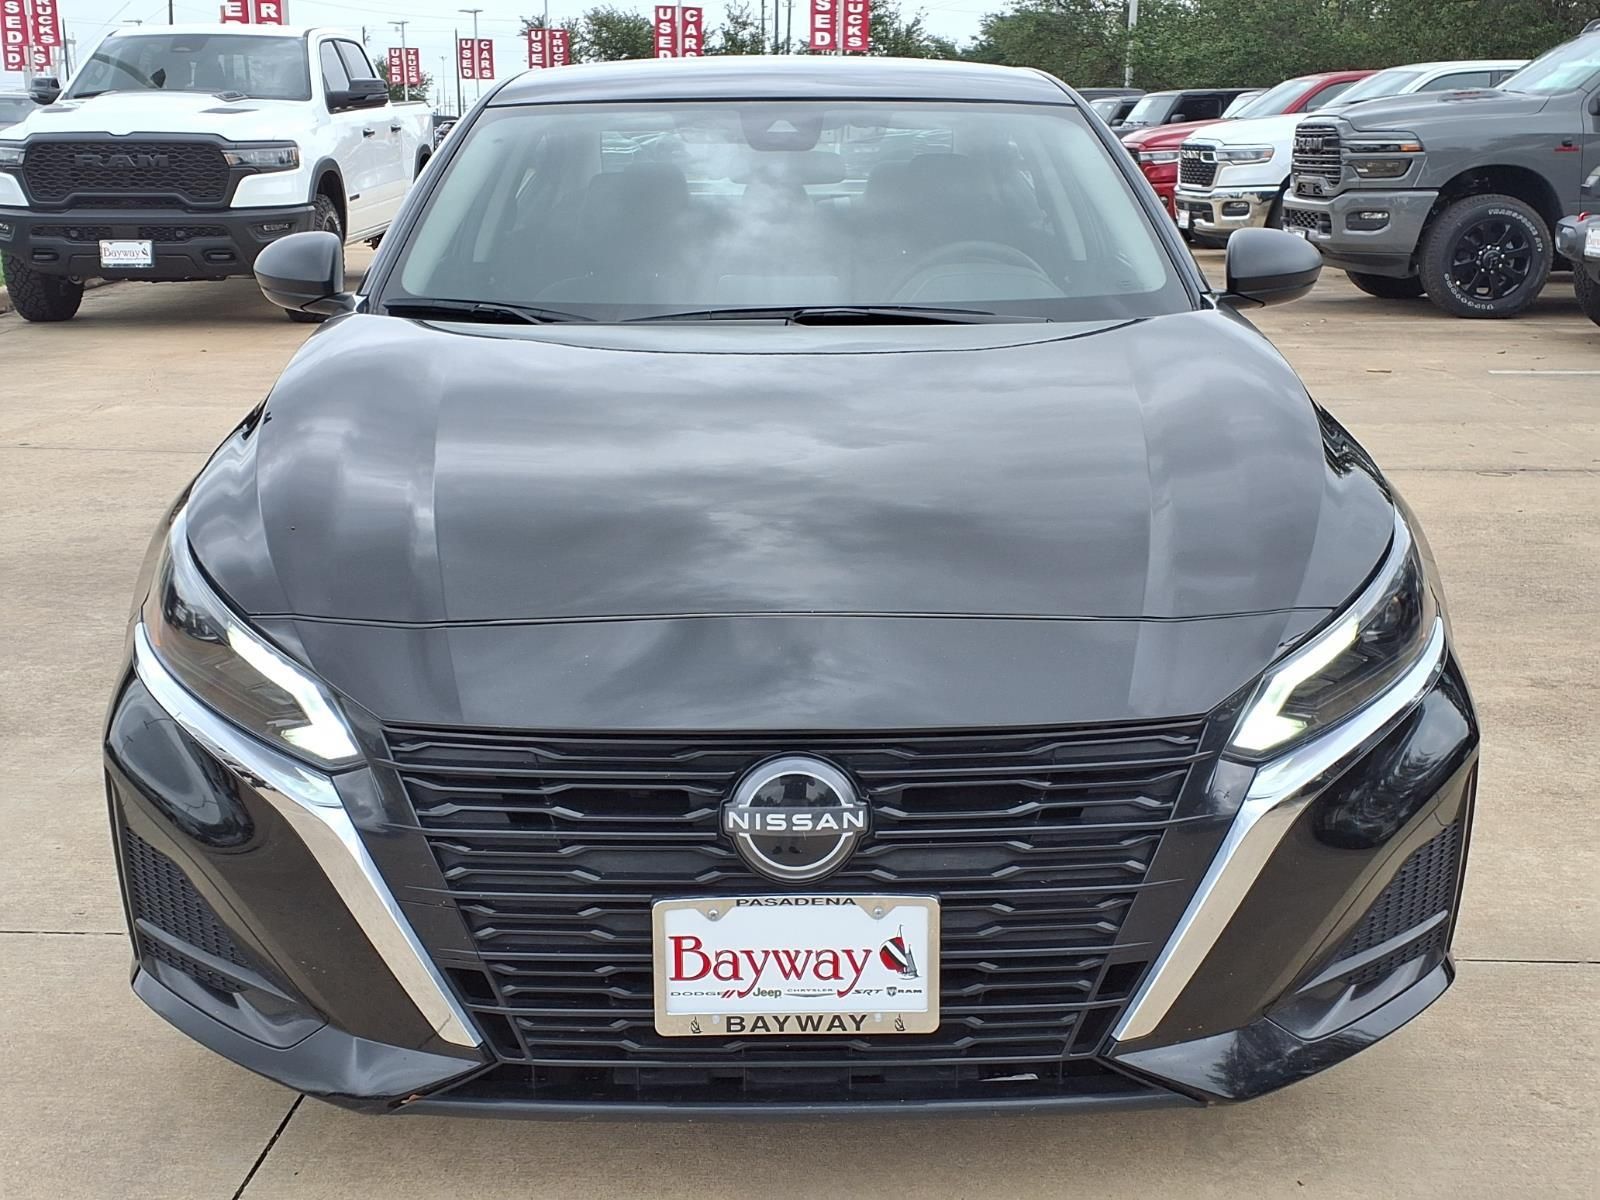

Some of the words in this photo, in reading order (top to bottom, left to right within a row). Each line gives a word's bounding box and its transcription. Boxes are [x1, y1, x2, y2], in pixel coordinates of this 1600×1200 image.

[4, 1, 23, 43] SED
[35, 0, 55, 43] RUCKS
[815, 0, 831, 46] SED
[848, 0, 863, 46] UCKS
[391, 49, 401, 82] USED
[408, 49, 417, 82] TRUCKS
[462, 40, 472, 77] USED
[480, 41, 492, 78] CARS
[552, 32, 564, 67] TRUCK
[74, 154, 169, 167] RAM
[103, 247, 141, 260] Bayway
[728, 811, 864, 831] NISSAN
[736, 897, 857, 906] PASADENA
[668, 935, 873, 998] Bayway
[753, 988, 782, 998] Jeep
[726, 1015, 868, 1033] BAYWAY
